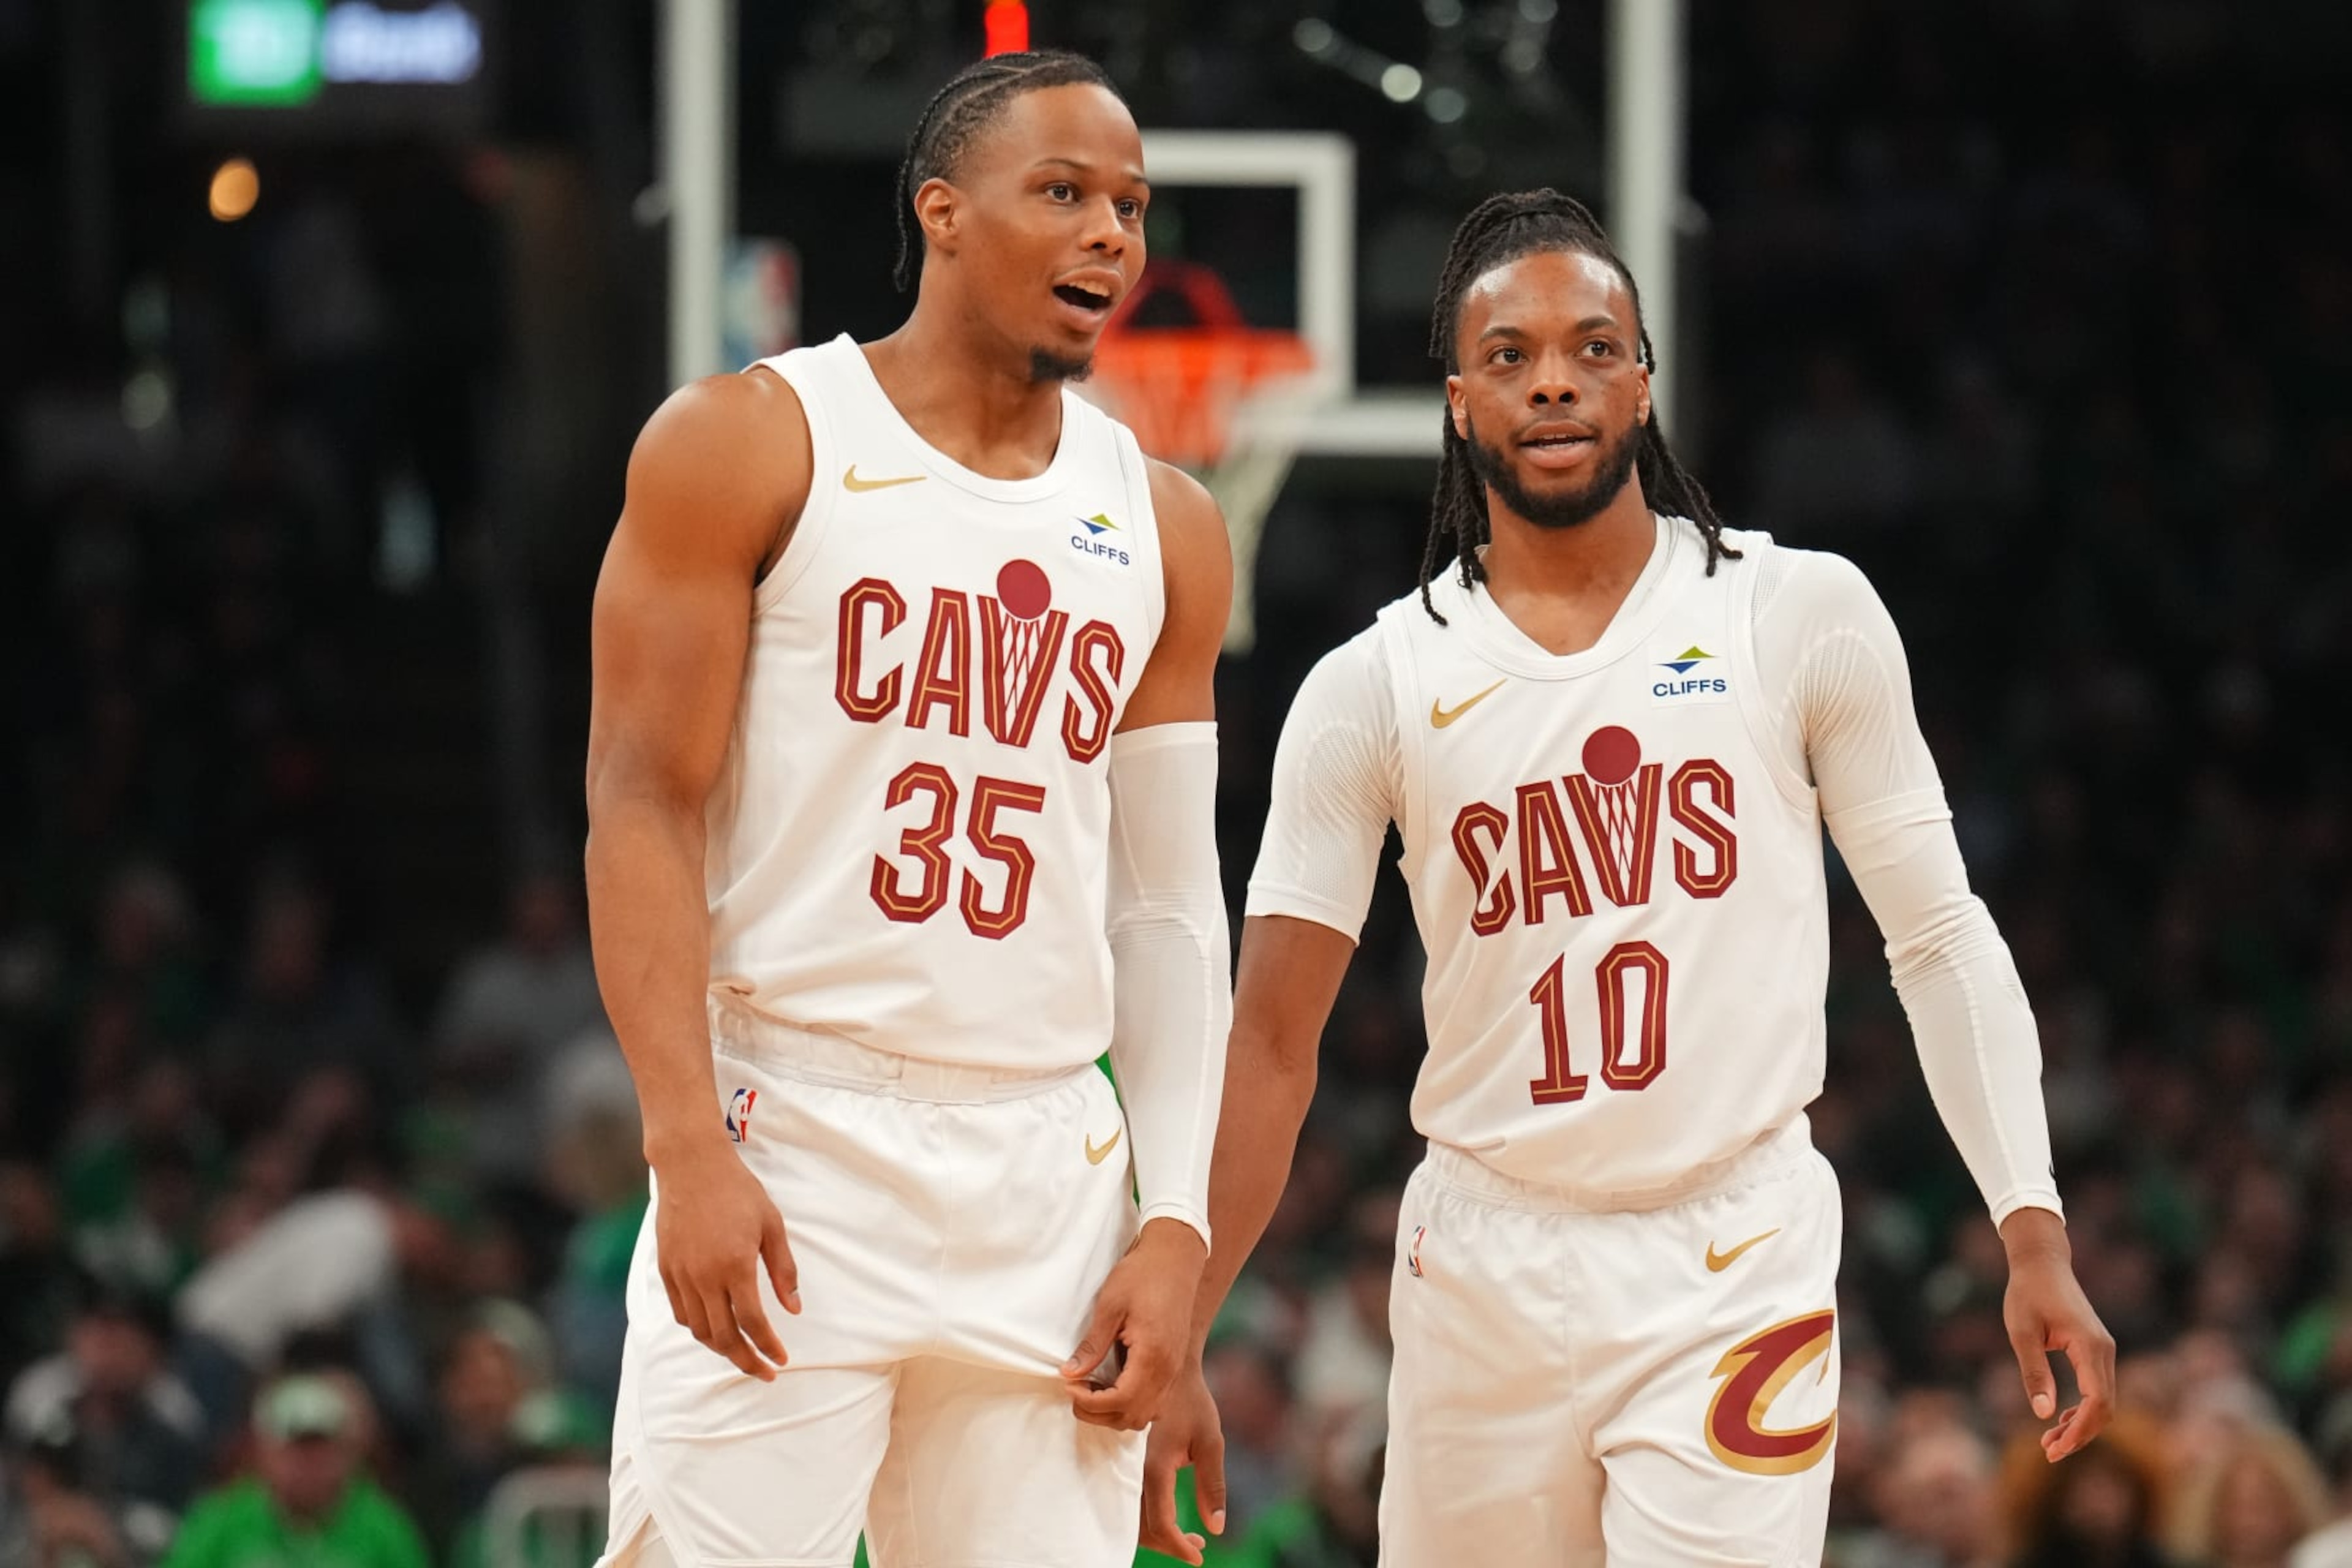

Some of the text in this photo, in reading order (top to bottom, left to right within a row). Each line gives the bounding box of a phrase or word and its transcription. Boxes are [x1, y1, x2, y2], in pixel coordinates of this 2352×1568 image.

[1071, 535, 1129, 565] CLIFFS
[834, 577, 1125, 764] CAVS
[1653, 679, 1727, 697] CLIFFS
[870, 761, 1046, 941] 35
[1451, 758, 1737, 937] CAVS
[1530, 940, 1669, 1106] 10
